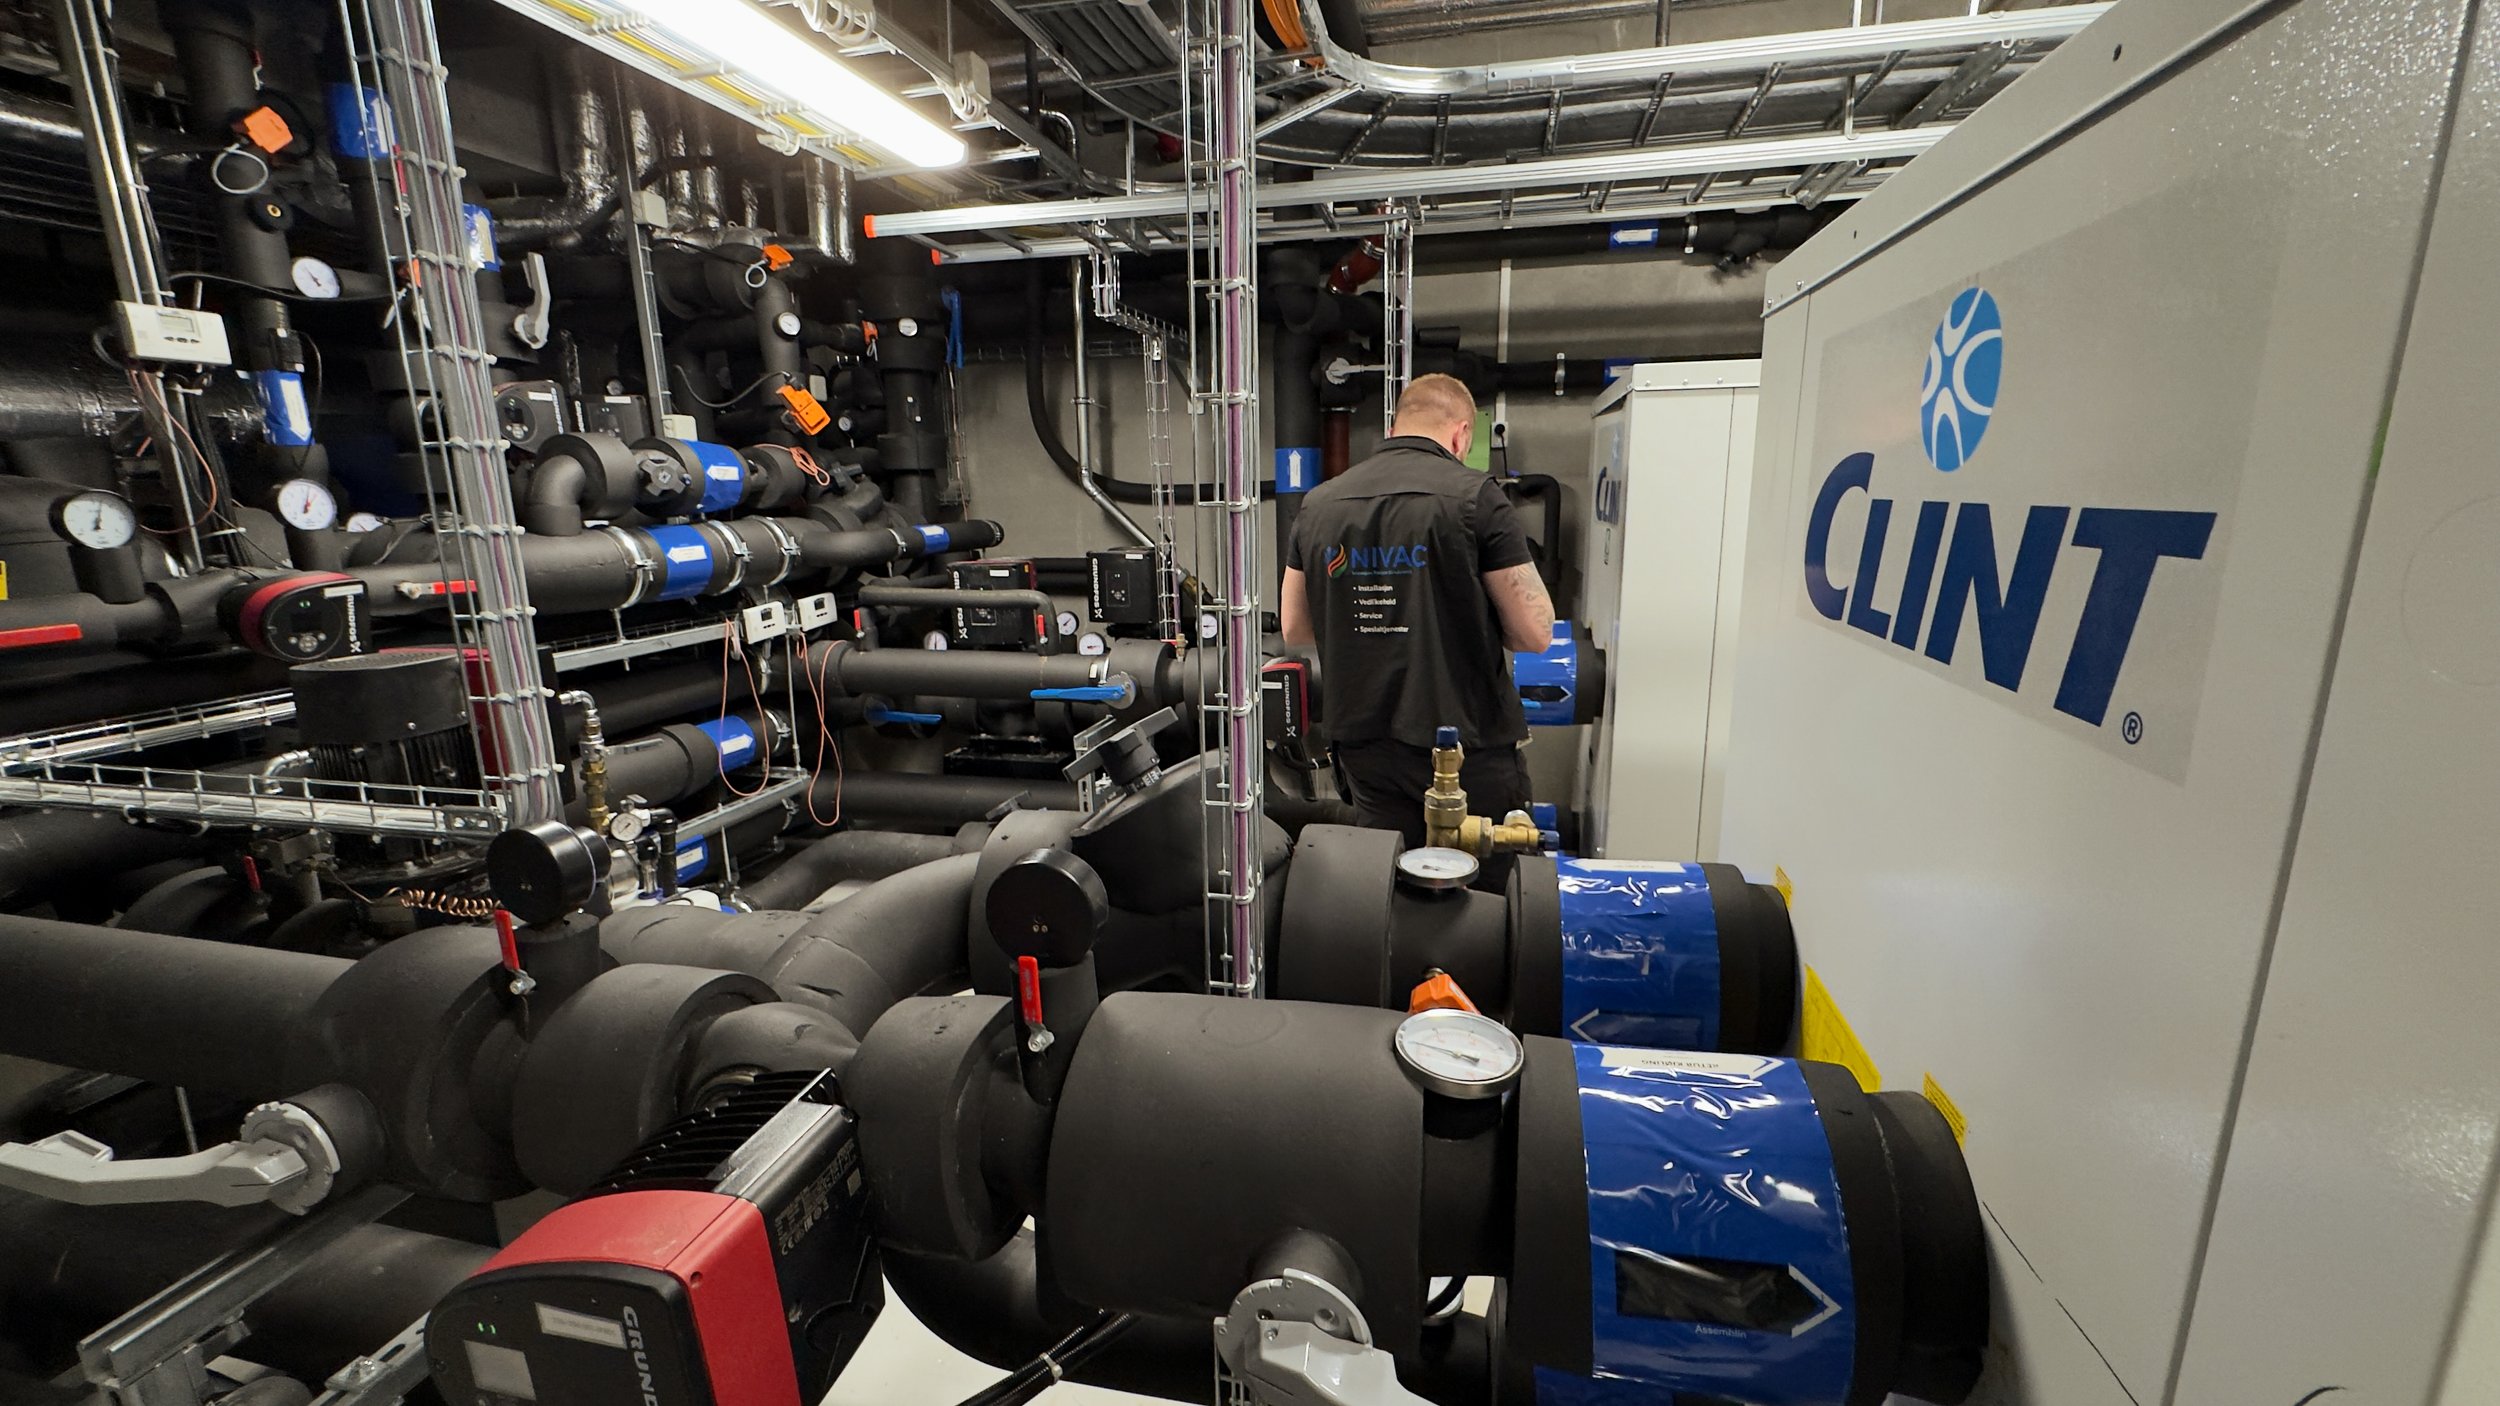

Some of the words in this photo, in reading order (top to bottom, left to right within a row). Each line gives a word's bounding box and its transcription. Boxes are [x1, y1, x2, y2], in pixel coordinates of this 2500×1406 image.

[1351, 544, 1428, 568] NIVAC
[1092, 558, 1101, 608] GRUNDFOS
[1804, 452, 2218, 727] CLINT
[347, 594, 357, 642] RUNDFOS
